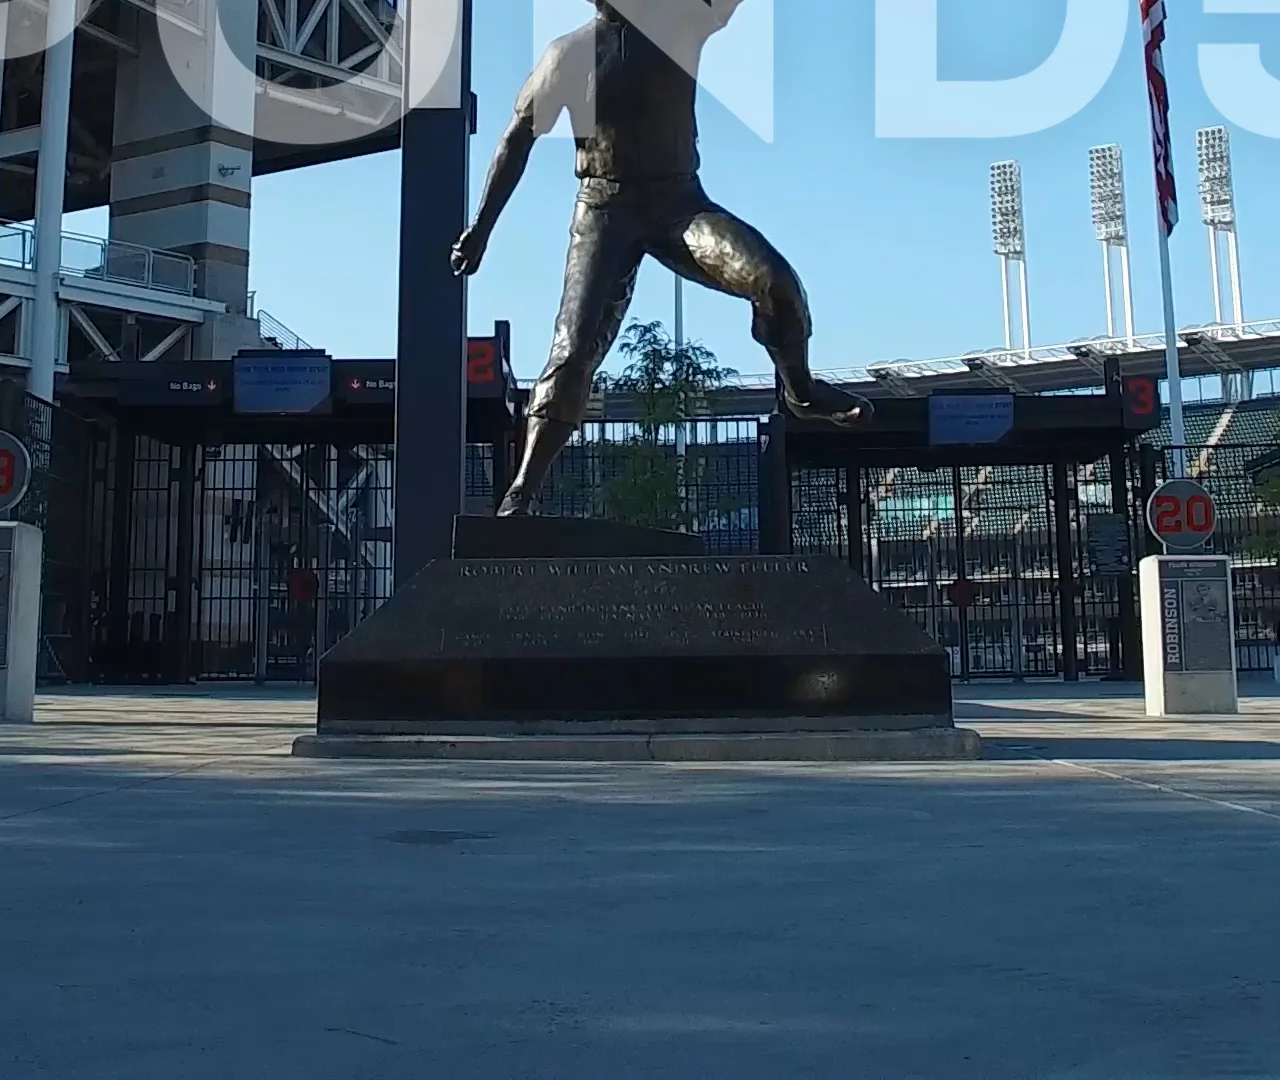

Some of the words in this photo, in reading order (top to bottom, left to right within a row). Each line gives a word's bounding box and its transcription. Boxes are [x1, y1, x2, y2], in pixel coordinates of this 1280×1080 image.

[170, 382, 180, 390] No
[182, 382, 202, 391] Bags
[366, 380, 377, 388] No
[1128, 378, 1154, 415] 3
[1154, 495, 1212, 533] 20
[460, 564, 534, 577] ROBERT
[548, 564, 634, 576] WILLIAM
[647, 563, 731, 575] ANDREW
[740, 561, 809, 575] FELLER
[1164, 588, 1180, 664] ROBINSON
